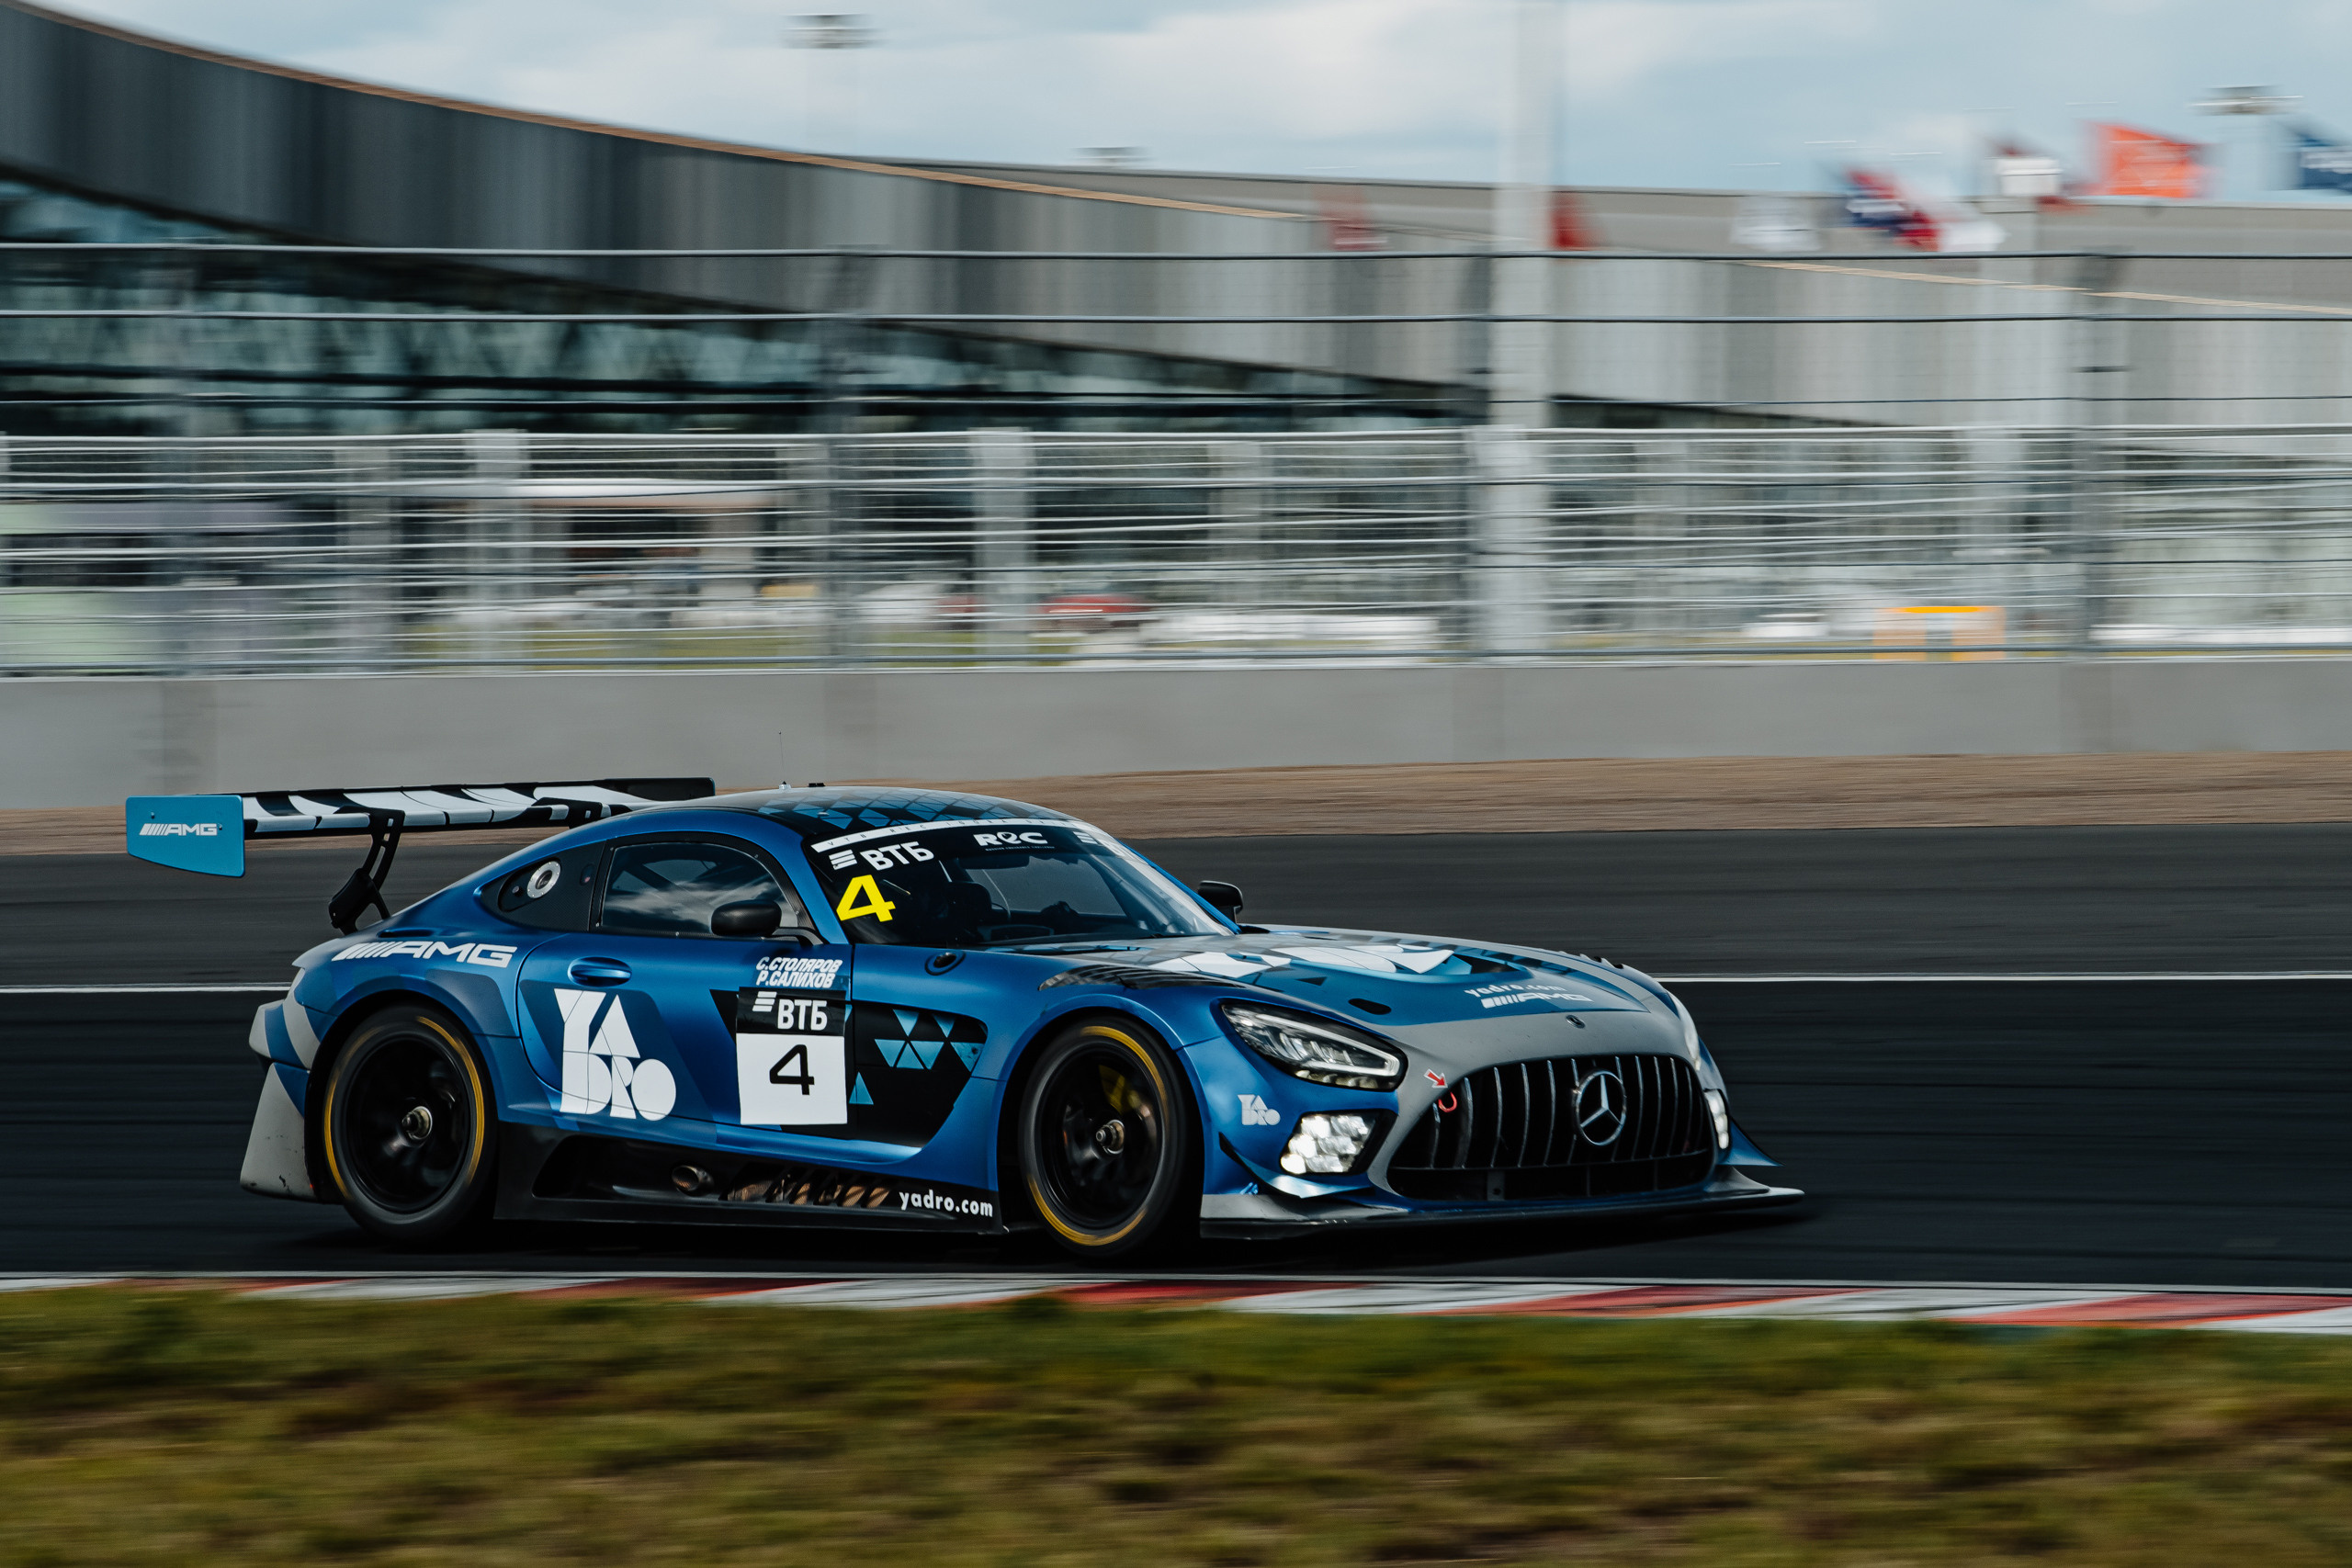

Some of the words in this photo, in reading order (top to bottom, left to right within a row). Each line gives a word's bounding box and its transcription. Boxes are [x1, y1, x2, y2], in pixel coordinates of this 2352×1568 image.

[165, 823, 218, 836] AMG
[860, 841, 934, 871] ВТБ
[836, 874, 897, 922] 4
[379, 941, 518, 968] AMG
[756, 956, 843, 973] С.СТОЛЯРОВ
[755, 970, 836, 988] Р.САЛИХОВ
[777, 998, 828, 1031] ВТБ
[769, 1044, 815, 1095] 4
[899, 1189, 993, 1217] yadro.com
